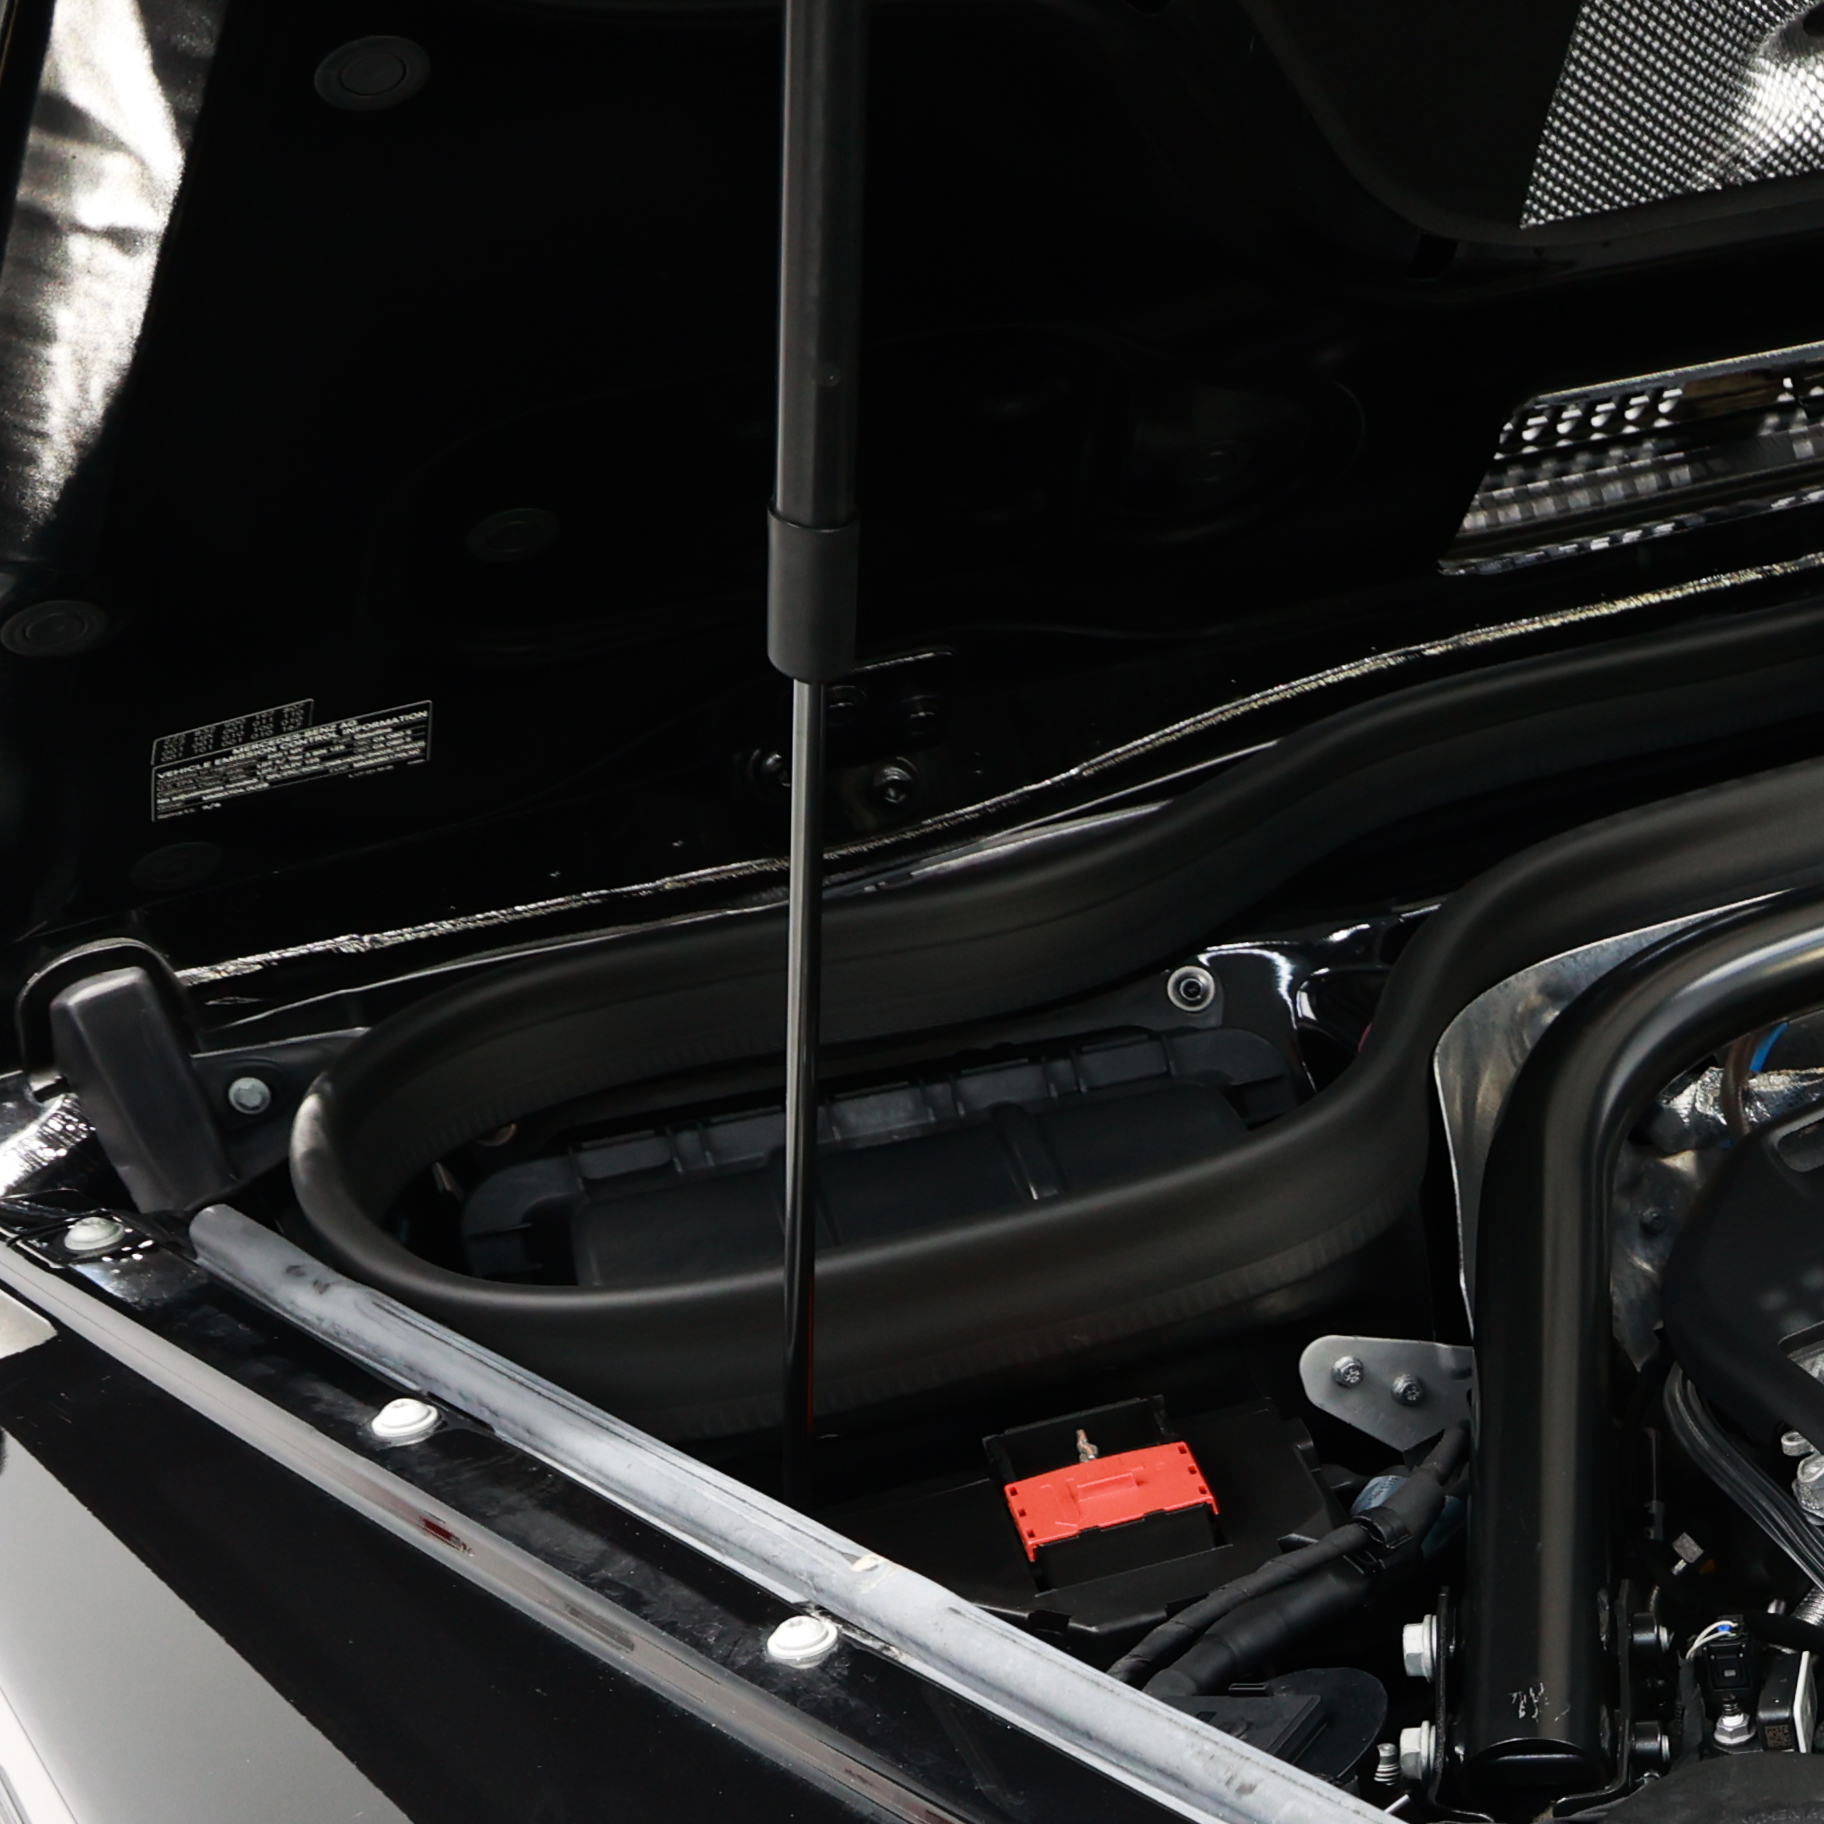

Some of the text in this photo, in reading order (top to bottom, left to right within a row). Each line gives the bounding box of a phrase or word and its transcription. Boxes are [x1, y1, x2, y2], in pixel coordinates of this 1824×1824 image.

[156, 762, 211, 780] VEHICLE
[213, 746, 277, 766] EMISSION
[278, 731, 339, 750] CONTROL
[341, 709, 428, 736] INFORMATION
[231, 725, 336, 755] MERCEDES-BENZ
[338, 720, 358, 729] AG
